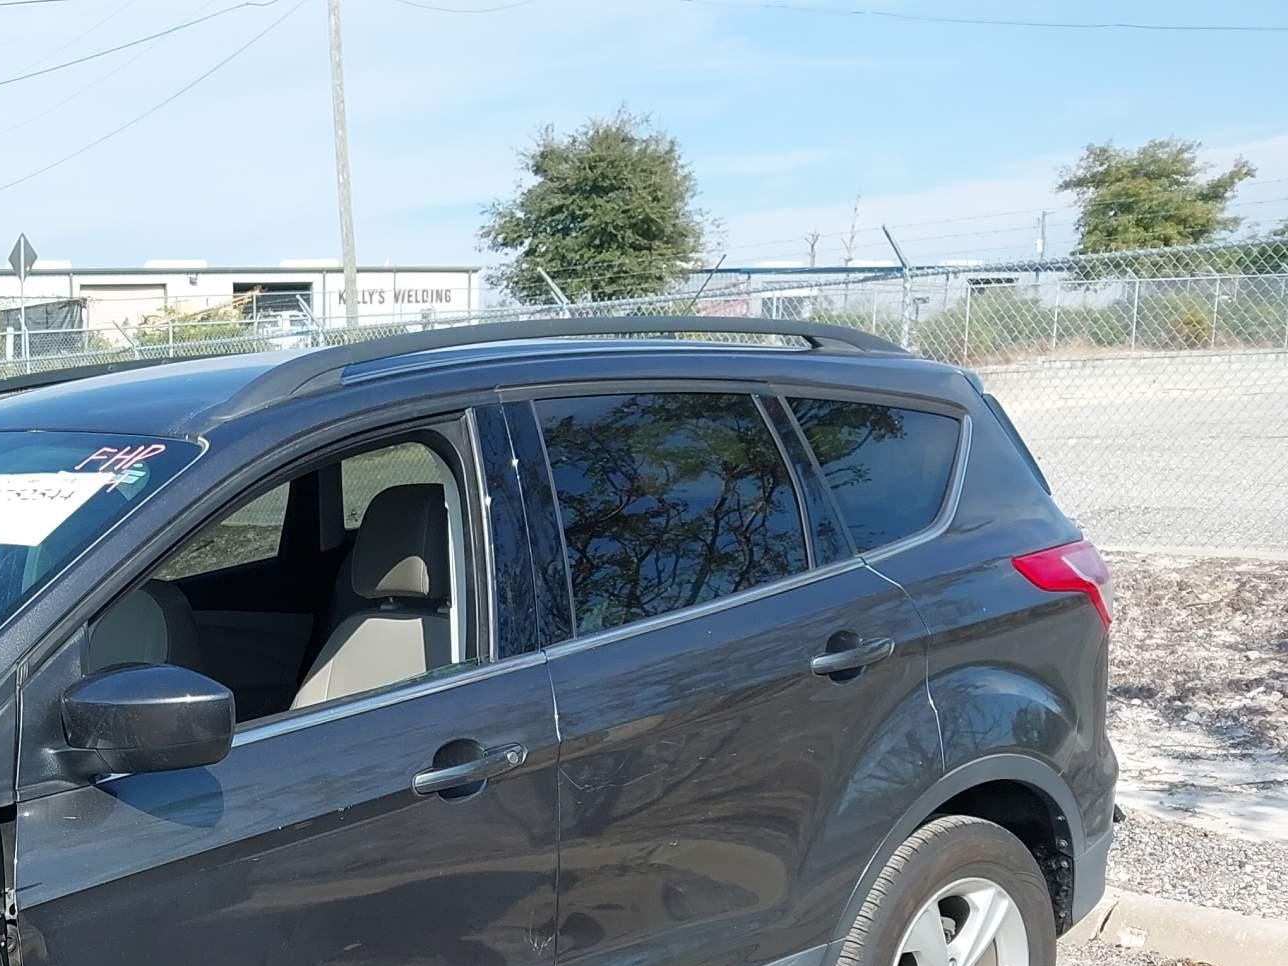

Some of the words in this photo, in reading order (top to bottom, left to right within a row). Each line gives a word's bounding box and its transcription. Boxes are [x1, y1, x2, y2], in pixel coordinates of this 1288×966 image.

[338, 289, 385, 304] KLY'S
[393, 288, 452, 303] WELDING
[74, 444, 166, 471] FHP
